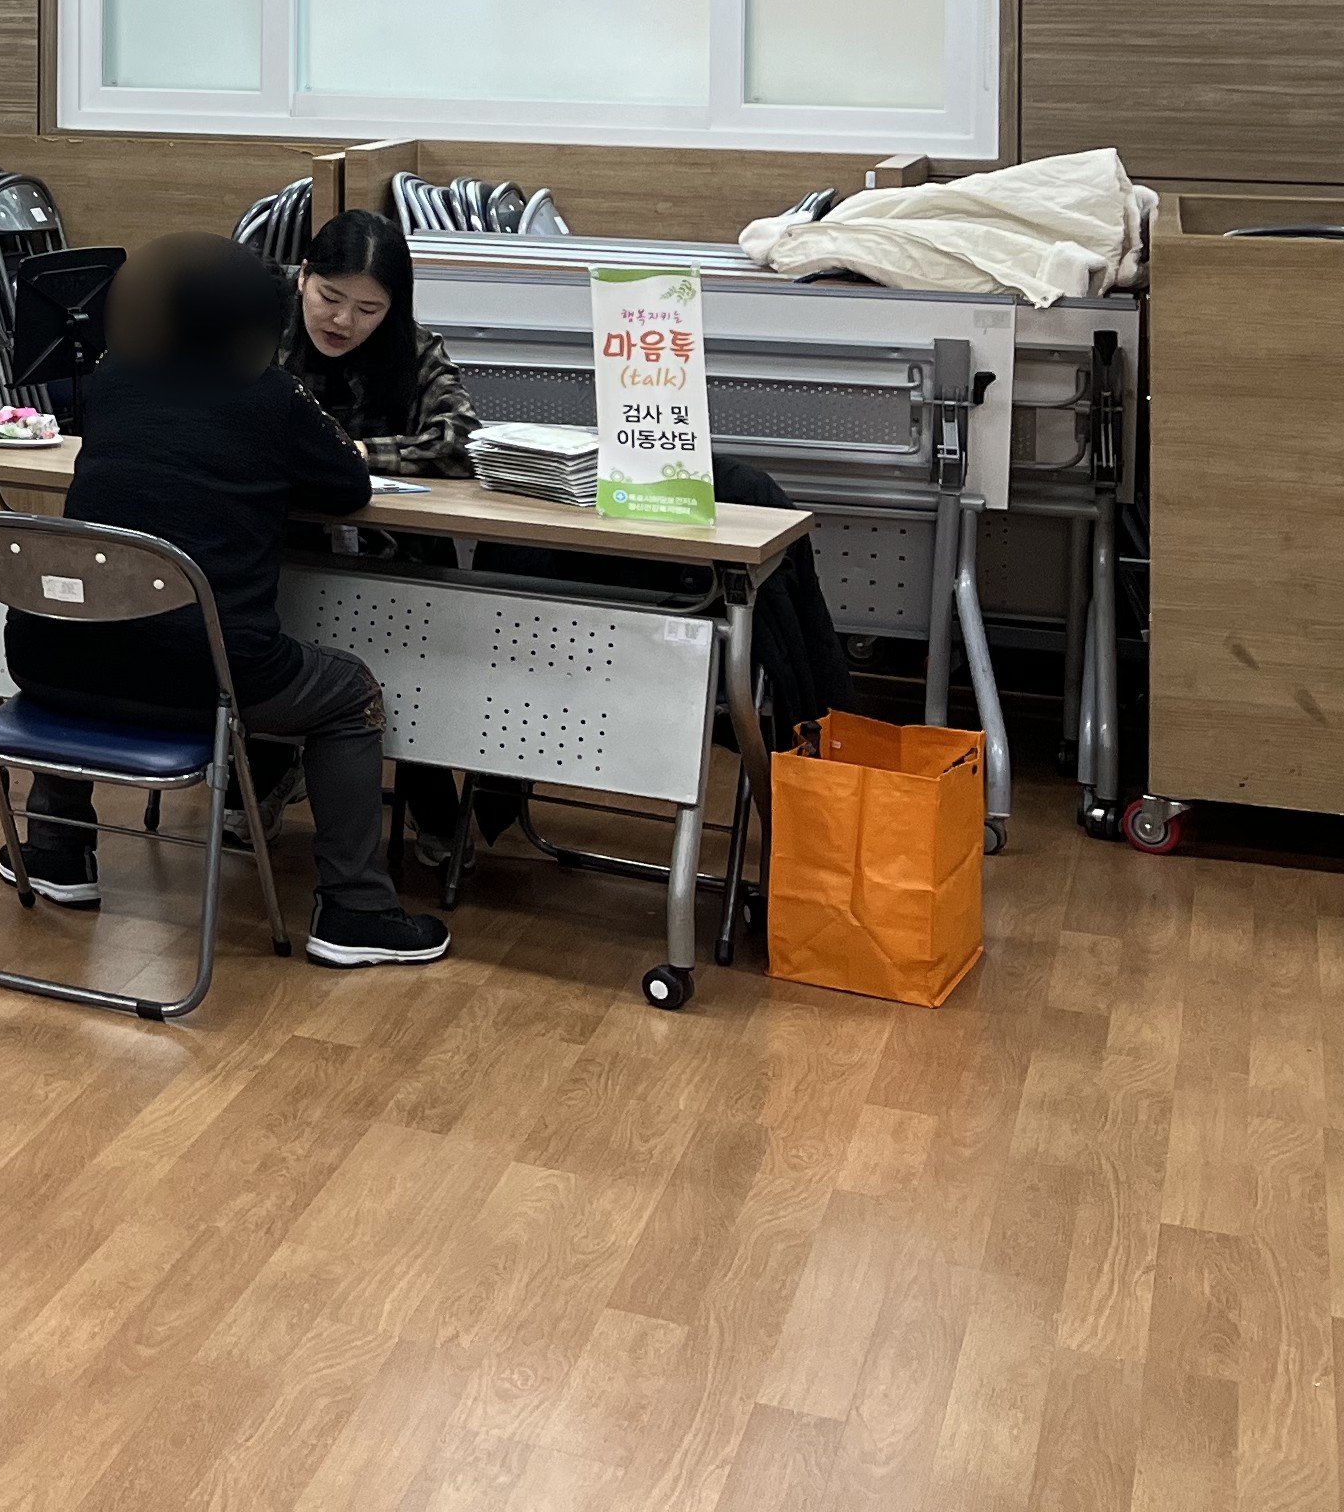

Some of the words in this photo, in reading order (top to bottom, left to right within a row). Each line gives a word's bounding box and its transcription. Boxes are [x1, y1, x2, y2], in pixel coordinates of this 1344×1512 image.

[620, 309, 683, 326] 행복지키는
[603, 329, 695, 364] 마음톡
[620, 364, 687, 390] (talk)
[622, 403, 662, 425] 검사
[671, 405, 689, 425] 및
[617, 429, 697, 451] 이동상담
